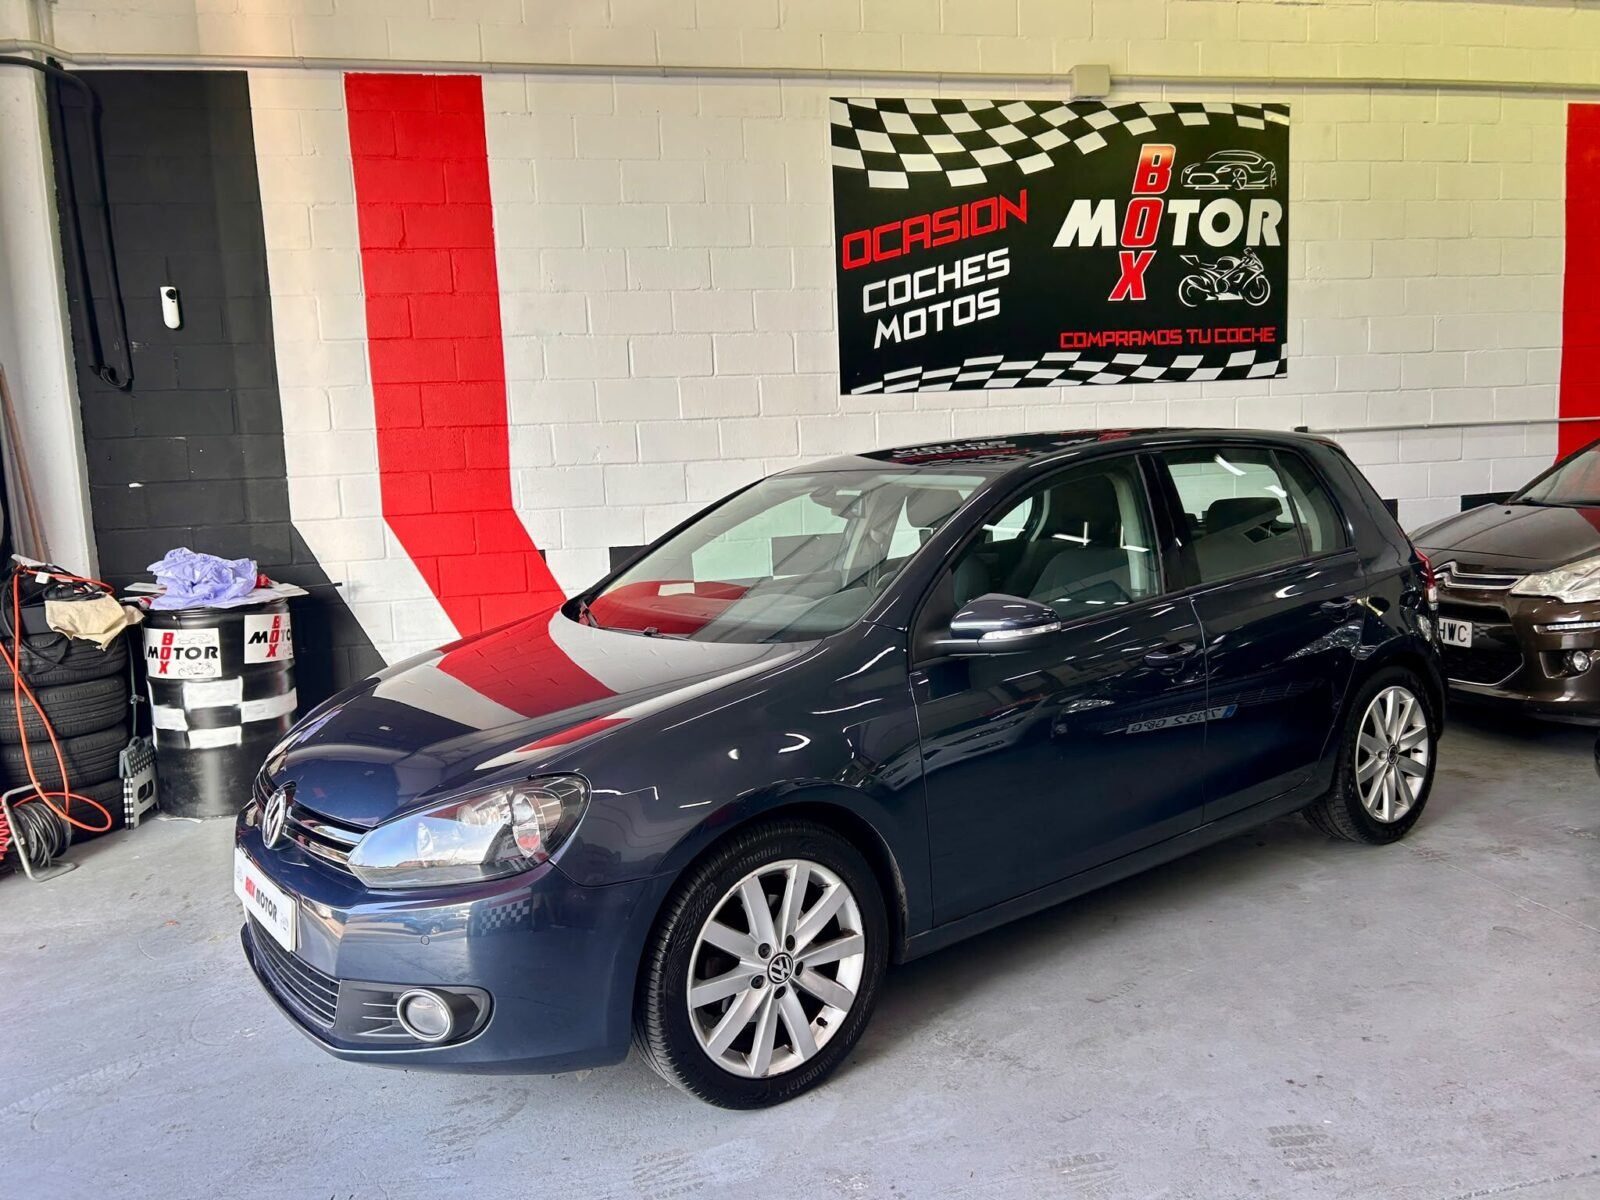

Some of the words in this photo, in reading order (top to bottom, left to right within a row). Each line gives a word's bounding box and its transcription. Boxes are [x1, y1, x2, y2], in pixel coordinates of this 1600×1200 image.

[842, 188, 1027, 270] OCASION
[1052, 198, 1283, 247] MOTOR
[1108, 143, 1176, 301] BOX
[862, 247, 1010, 313] COCHES
[874, 287, 1001, 349] MOTOS
[1060, 330, 1182, 348] COMPRAMOS
[1186, 328, 1211, 344] TU
[1214, 326, 1276, 343] COCHE
[147, 646, 219, 660] MOTOR
[158, 632, 174, 674] BOX
[255, 888, 278, 922] MOTOR
